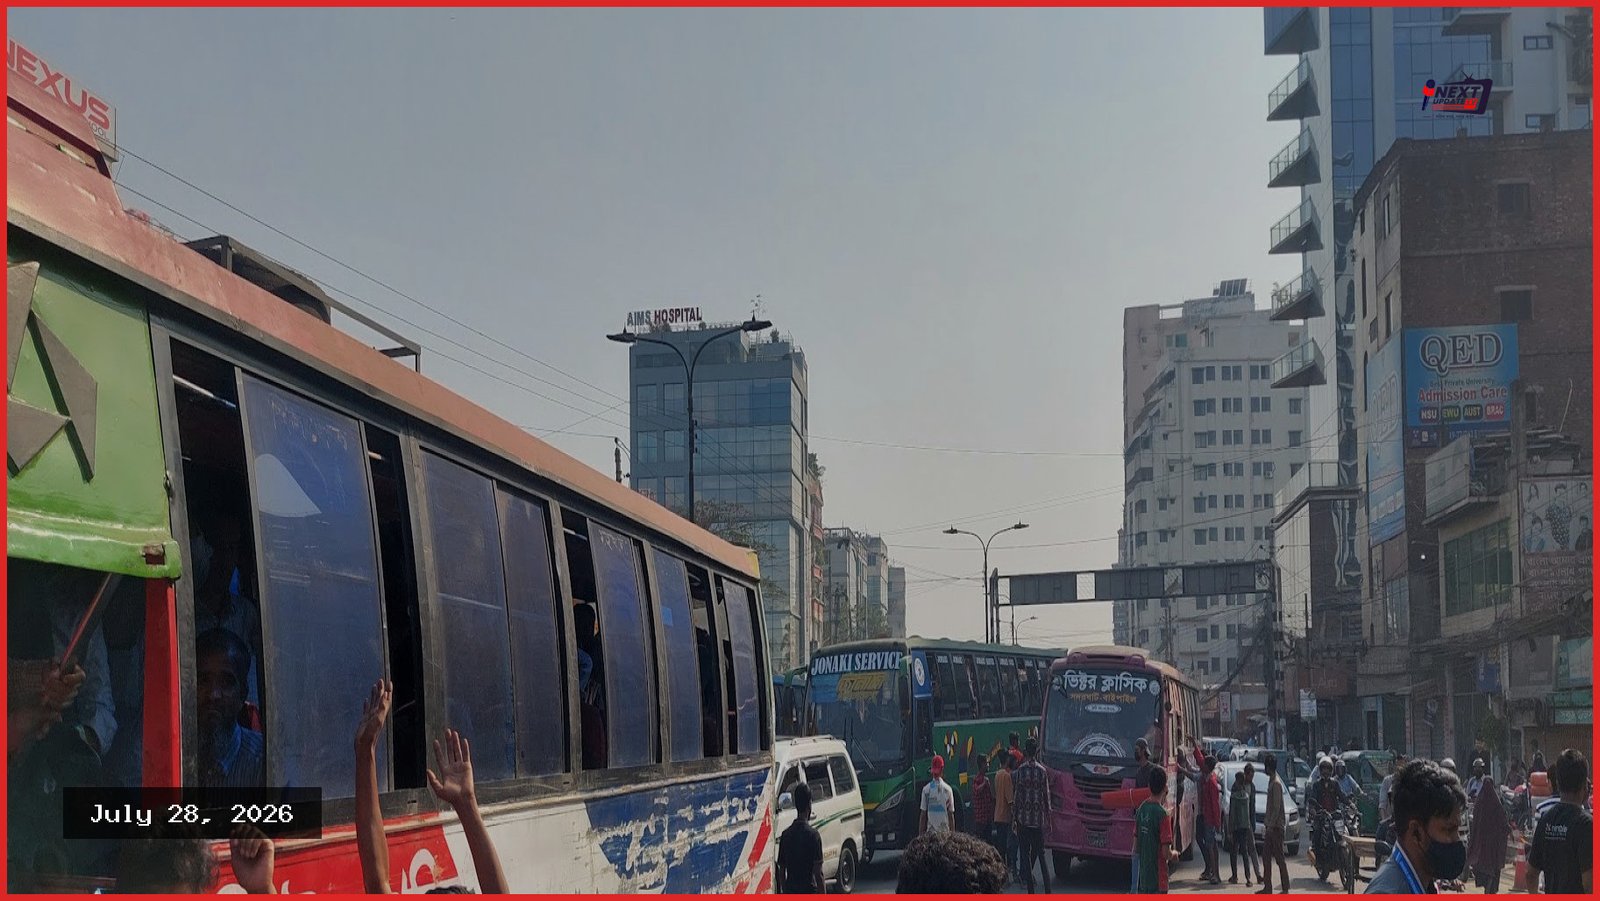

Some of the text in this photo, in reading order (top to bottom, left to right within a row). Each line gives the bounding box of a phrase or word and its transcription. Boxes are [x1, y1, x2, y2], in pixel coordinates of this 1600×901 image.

[627, 306, 702, 326] AIMS HOSPITAL
[1420, 332, 1503, 375] QED
[1418, 385, 1507, 402] Admission Care
[1421, 404, 1504, 420] NSU EWU AUST BRAC
[811, 651, 903, 676] JONAKI SERVICE
[1063, 669, 1148, 693] ভিক্টর ক্লাসিক
